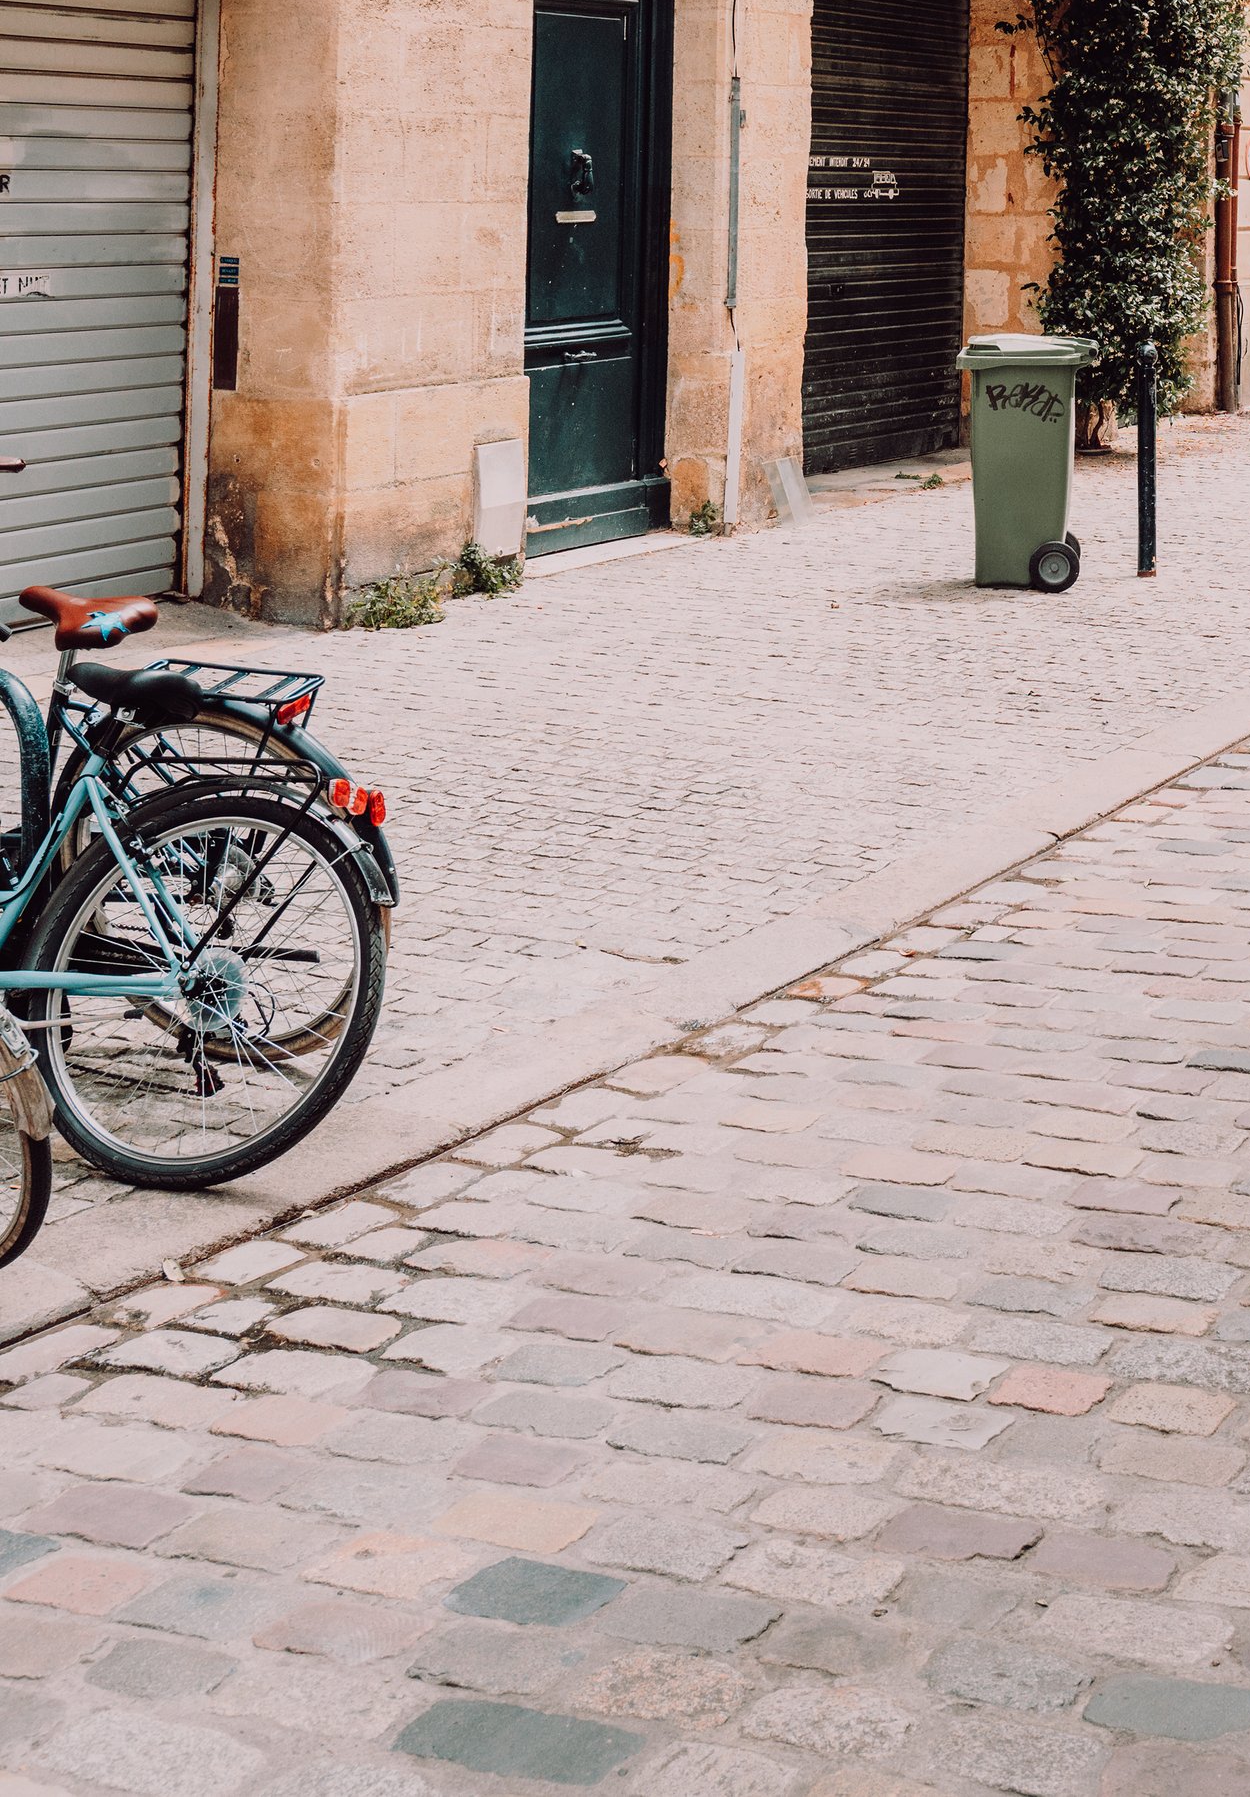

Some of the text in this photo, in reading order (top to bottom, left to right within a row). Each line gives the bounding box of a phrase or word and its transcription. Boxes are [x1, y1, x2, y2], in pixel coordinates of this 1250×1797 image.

[852, 157, 871, 168] 24/24
[806, 189, 823, 199] SORTIE
[825, 189, 832, 199] DE
